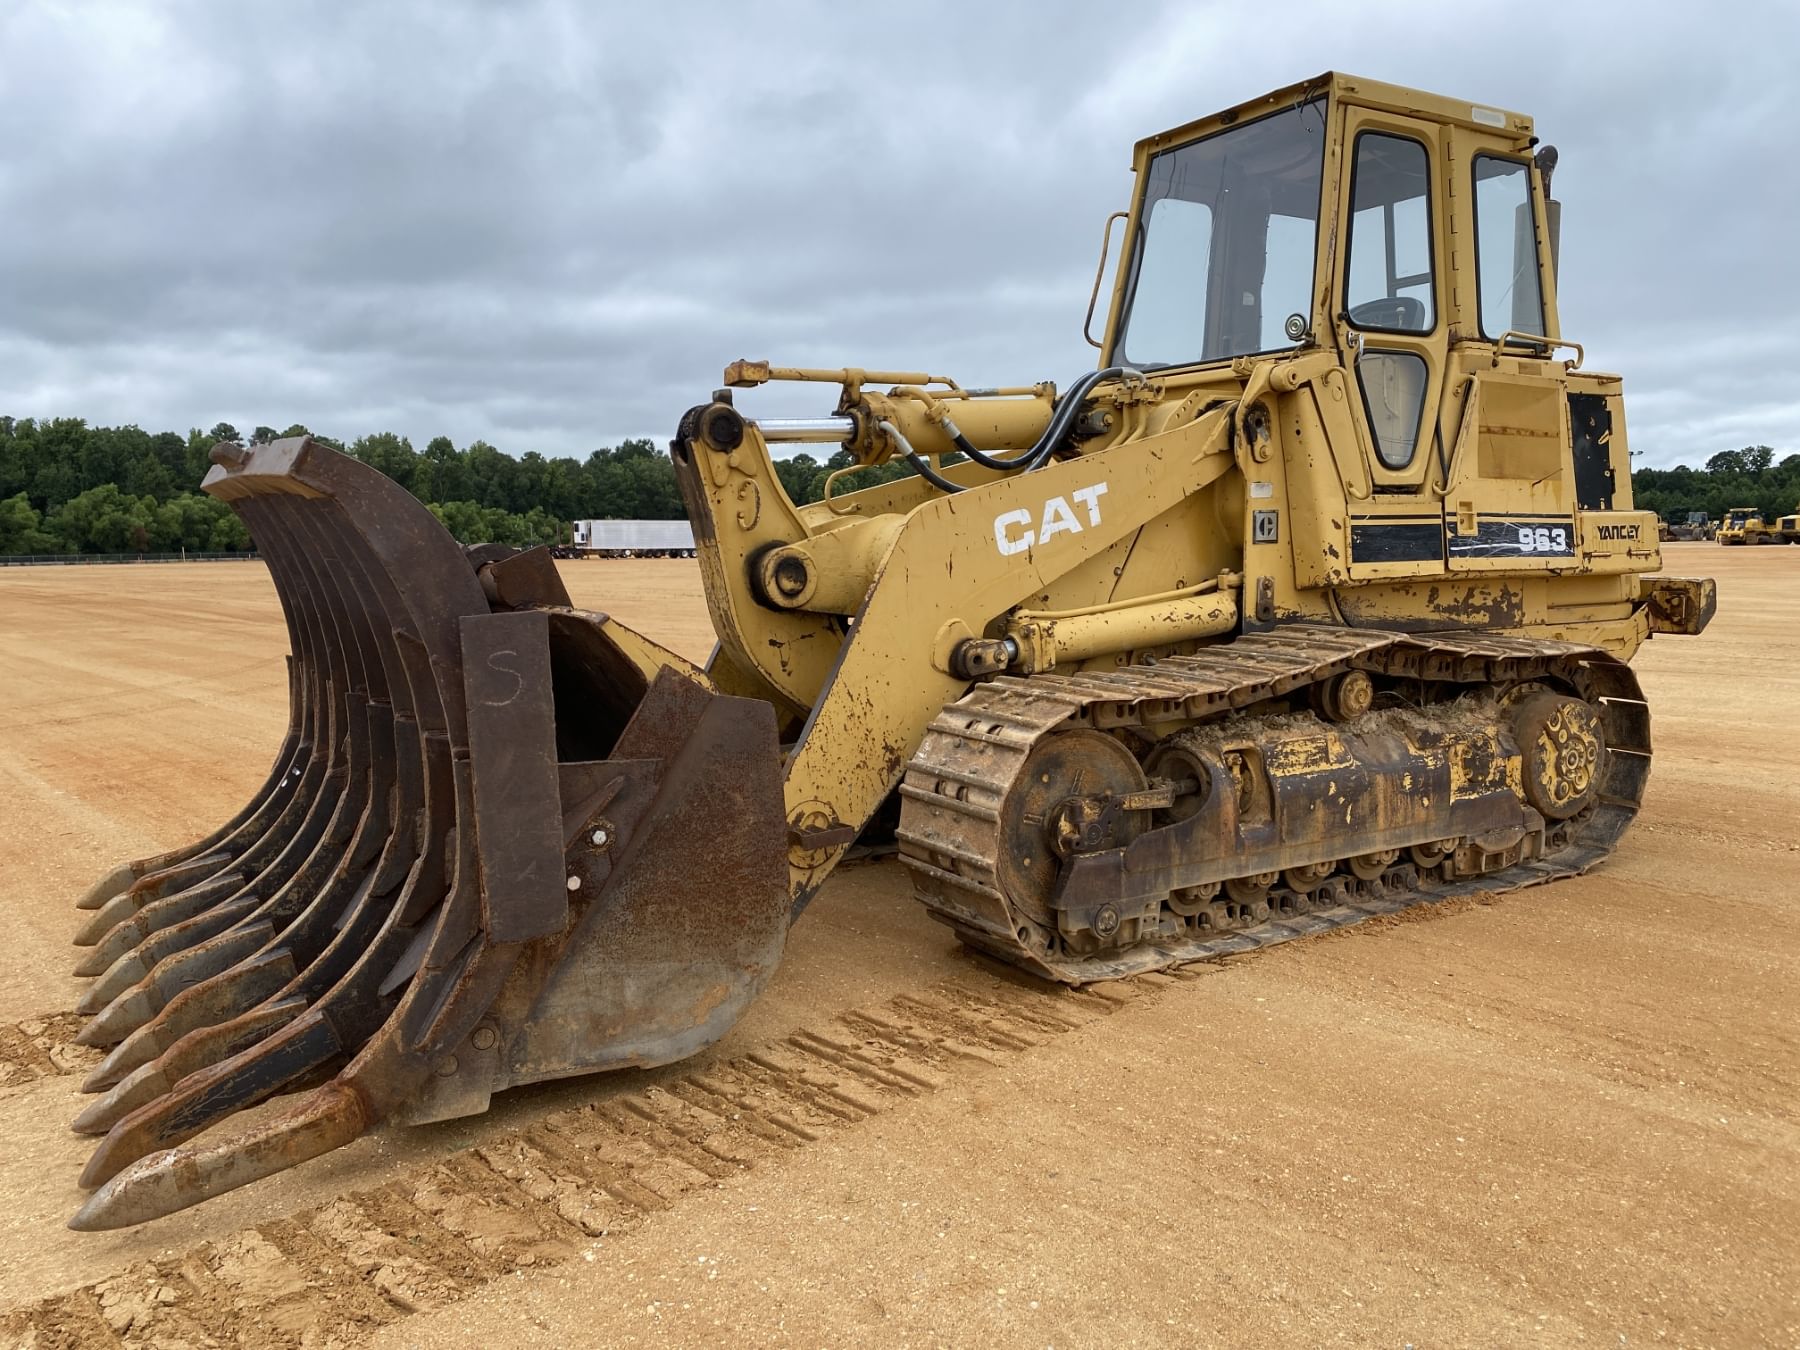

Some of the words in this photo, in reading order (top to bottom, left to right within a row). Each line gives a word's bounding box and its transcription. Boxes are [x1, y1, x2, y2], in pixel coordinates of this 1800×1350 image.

[993, 481, 1109, 556] CAT
[1518, 527, 1566, 552] 963
[1597, 524, 1641, 540] YANCEY
